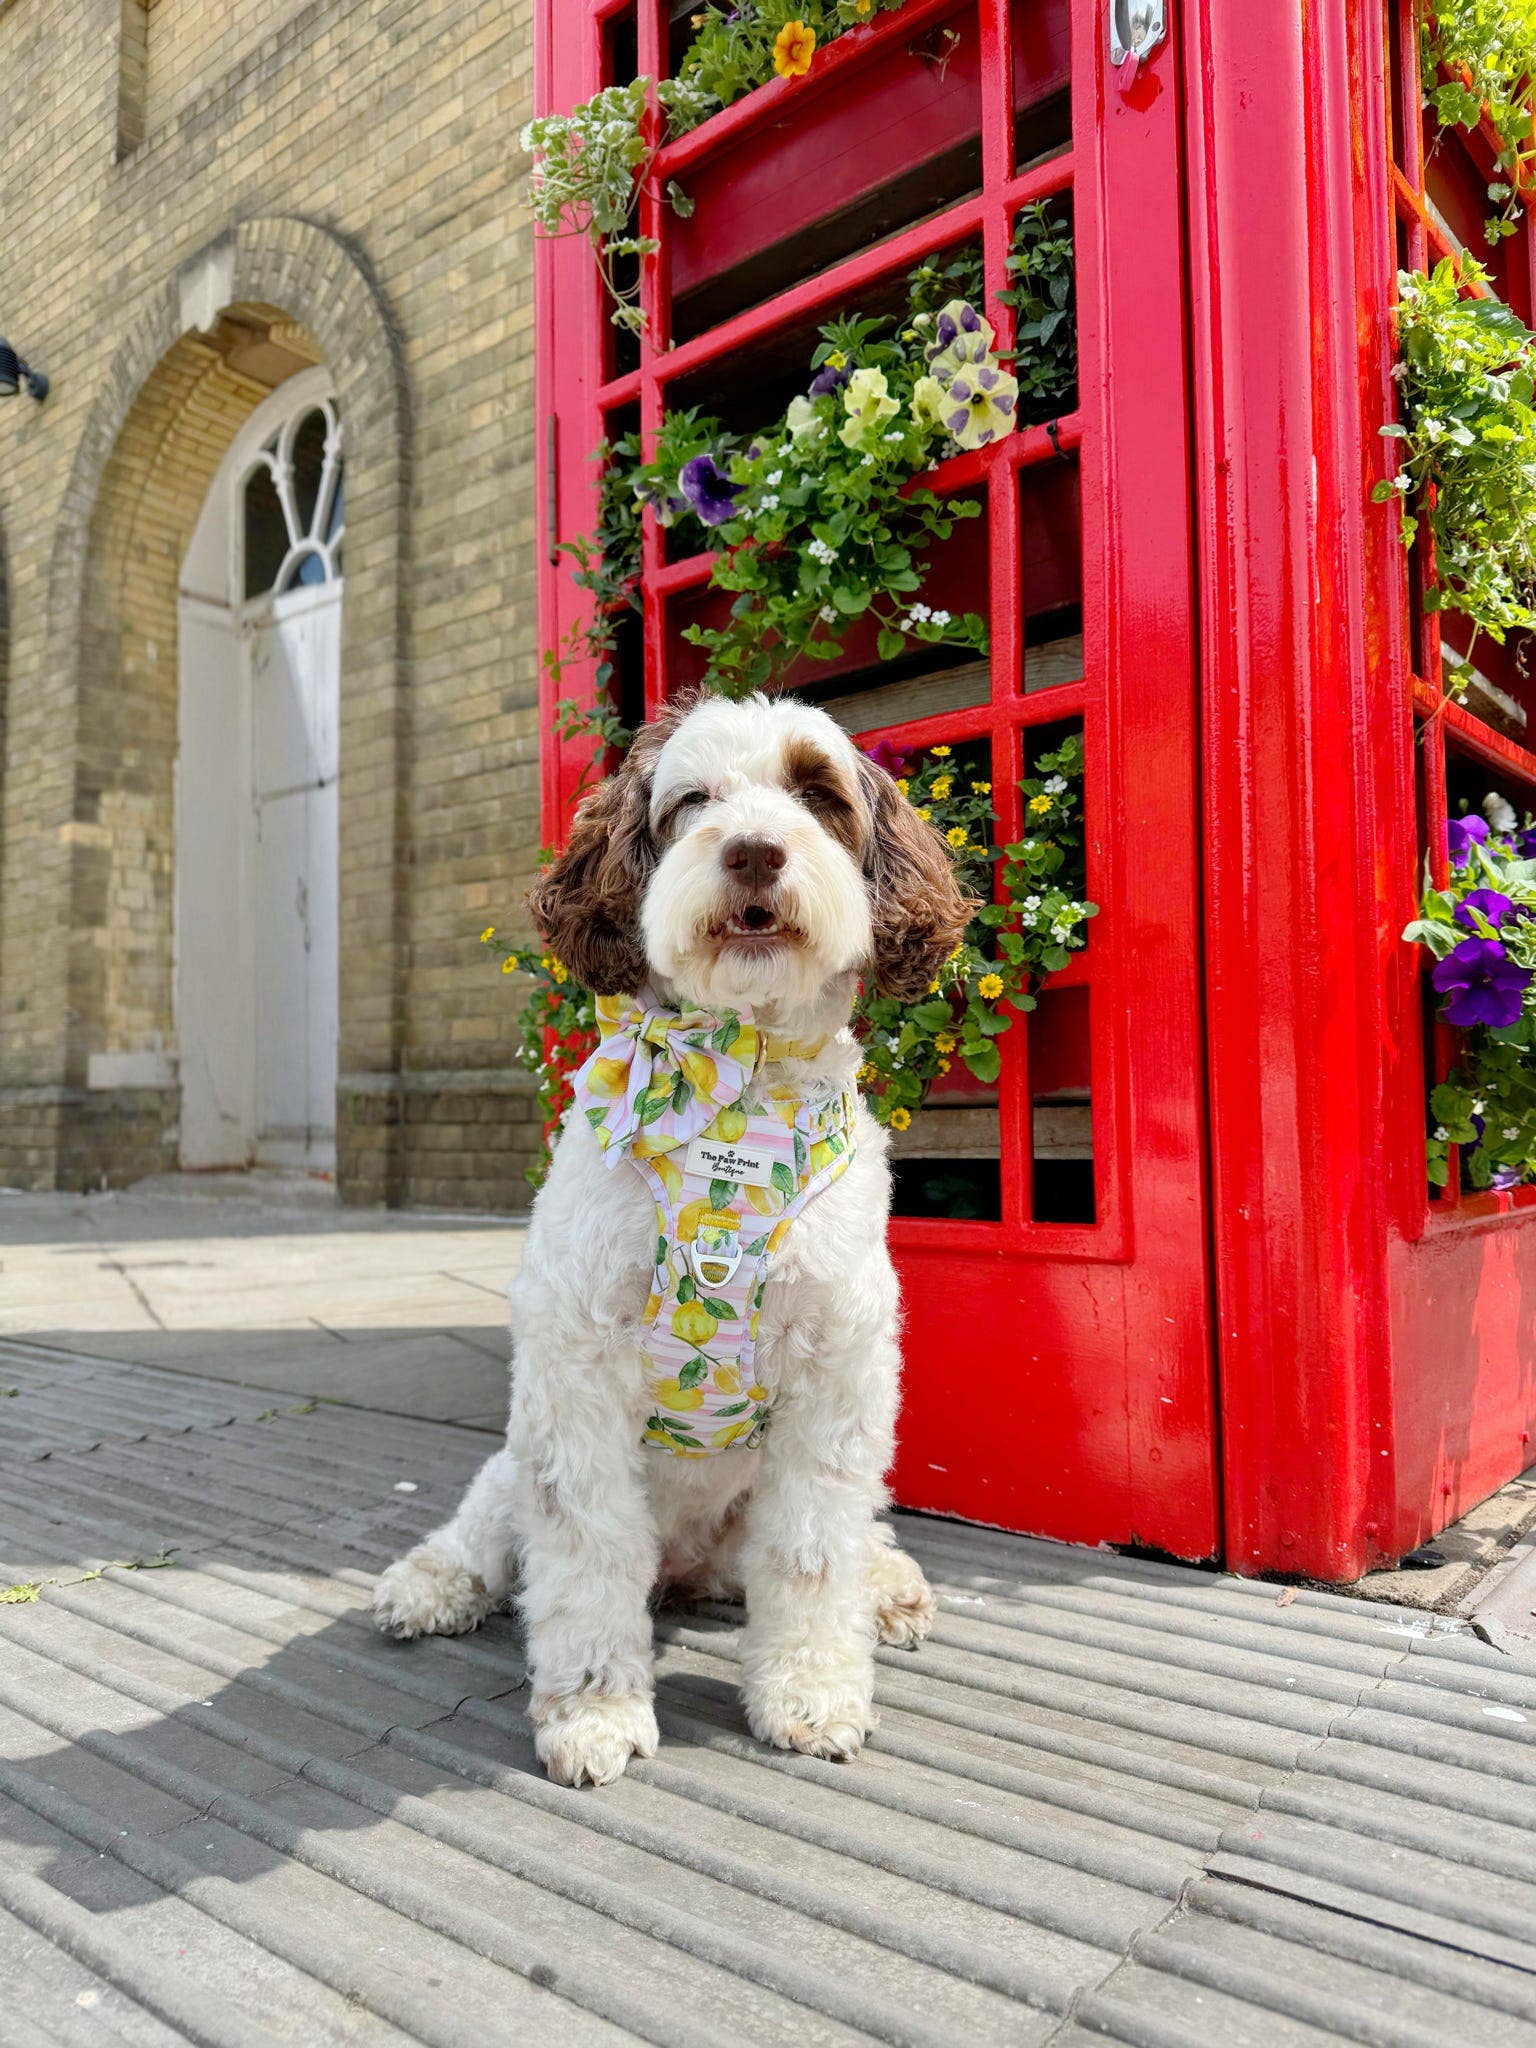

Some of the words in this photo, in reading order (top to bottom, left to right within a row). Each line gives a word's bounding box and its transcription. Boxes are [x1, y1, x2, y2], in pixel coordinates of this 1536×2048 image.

[701, 1151, 717, 1161] The
[718, 1155, 737, 1164] Paw
[737, 1158, 760, 1169] Print
[712, 1162, 744, 1177] Boutique
